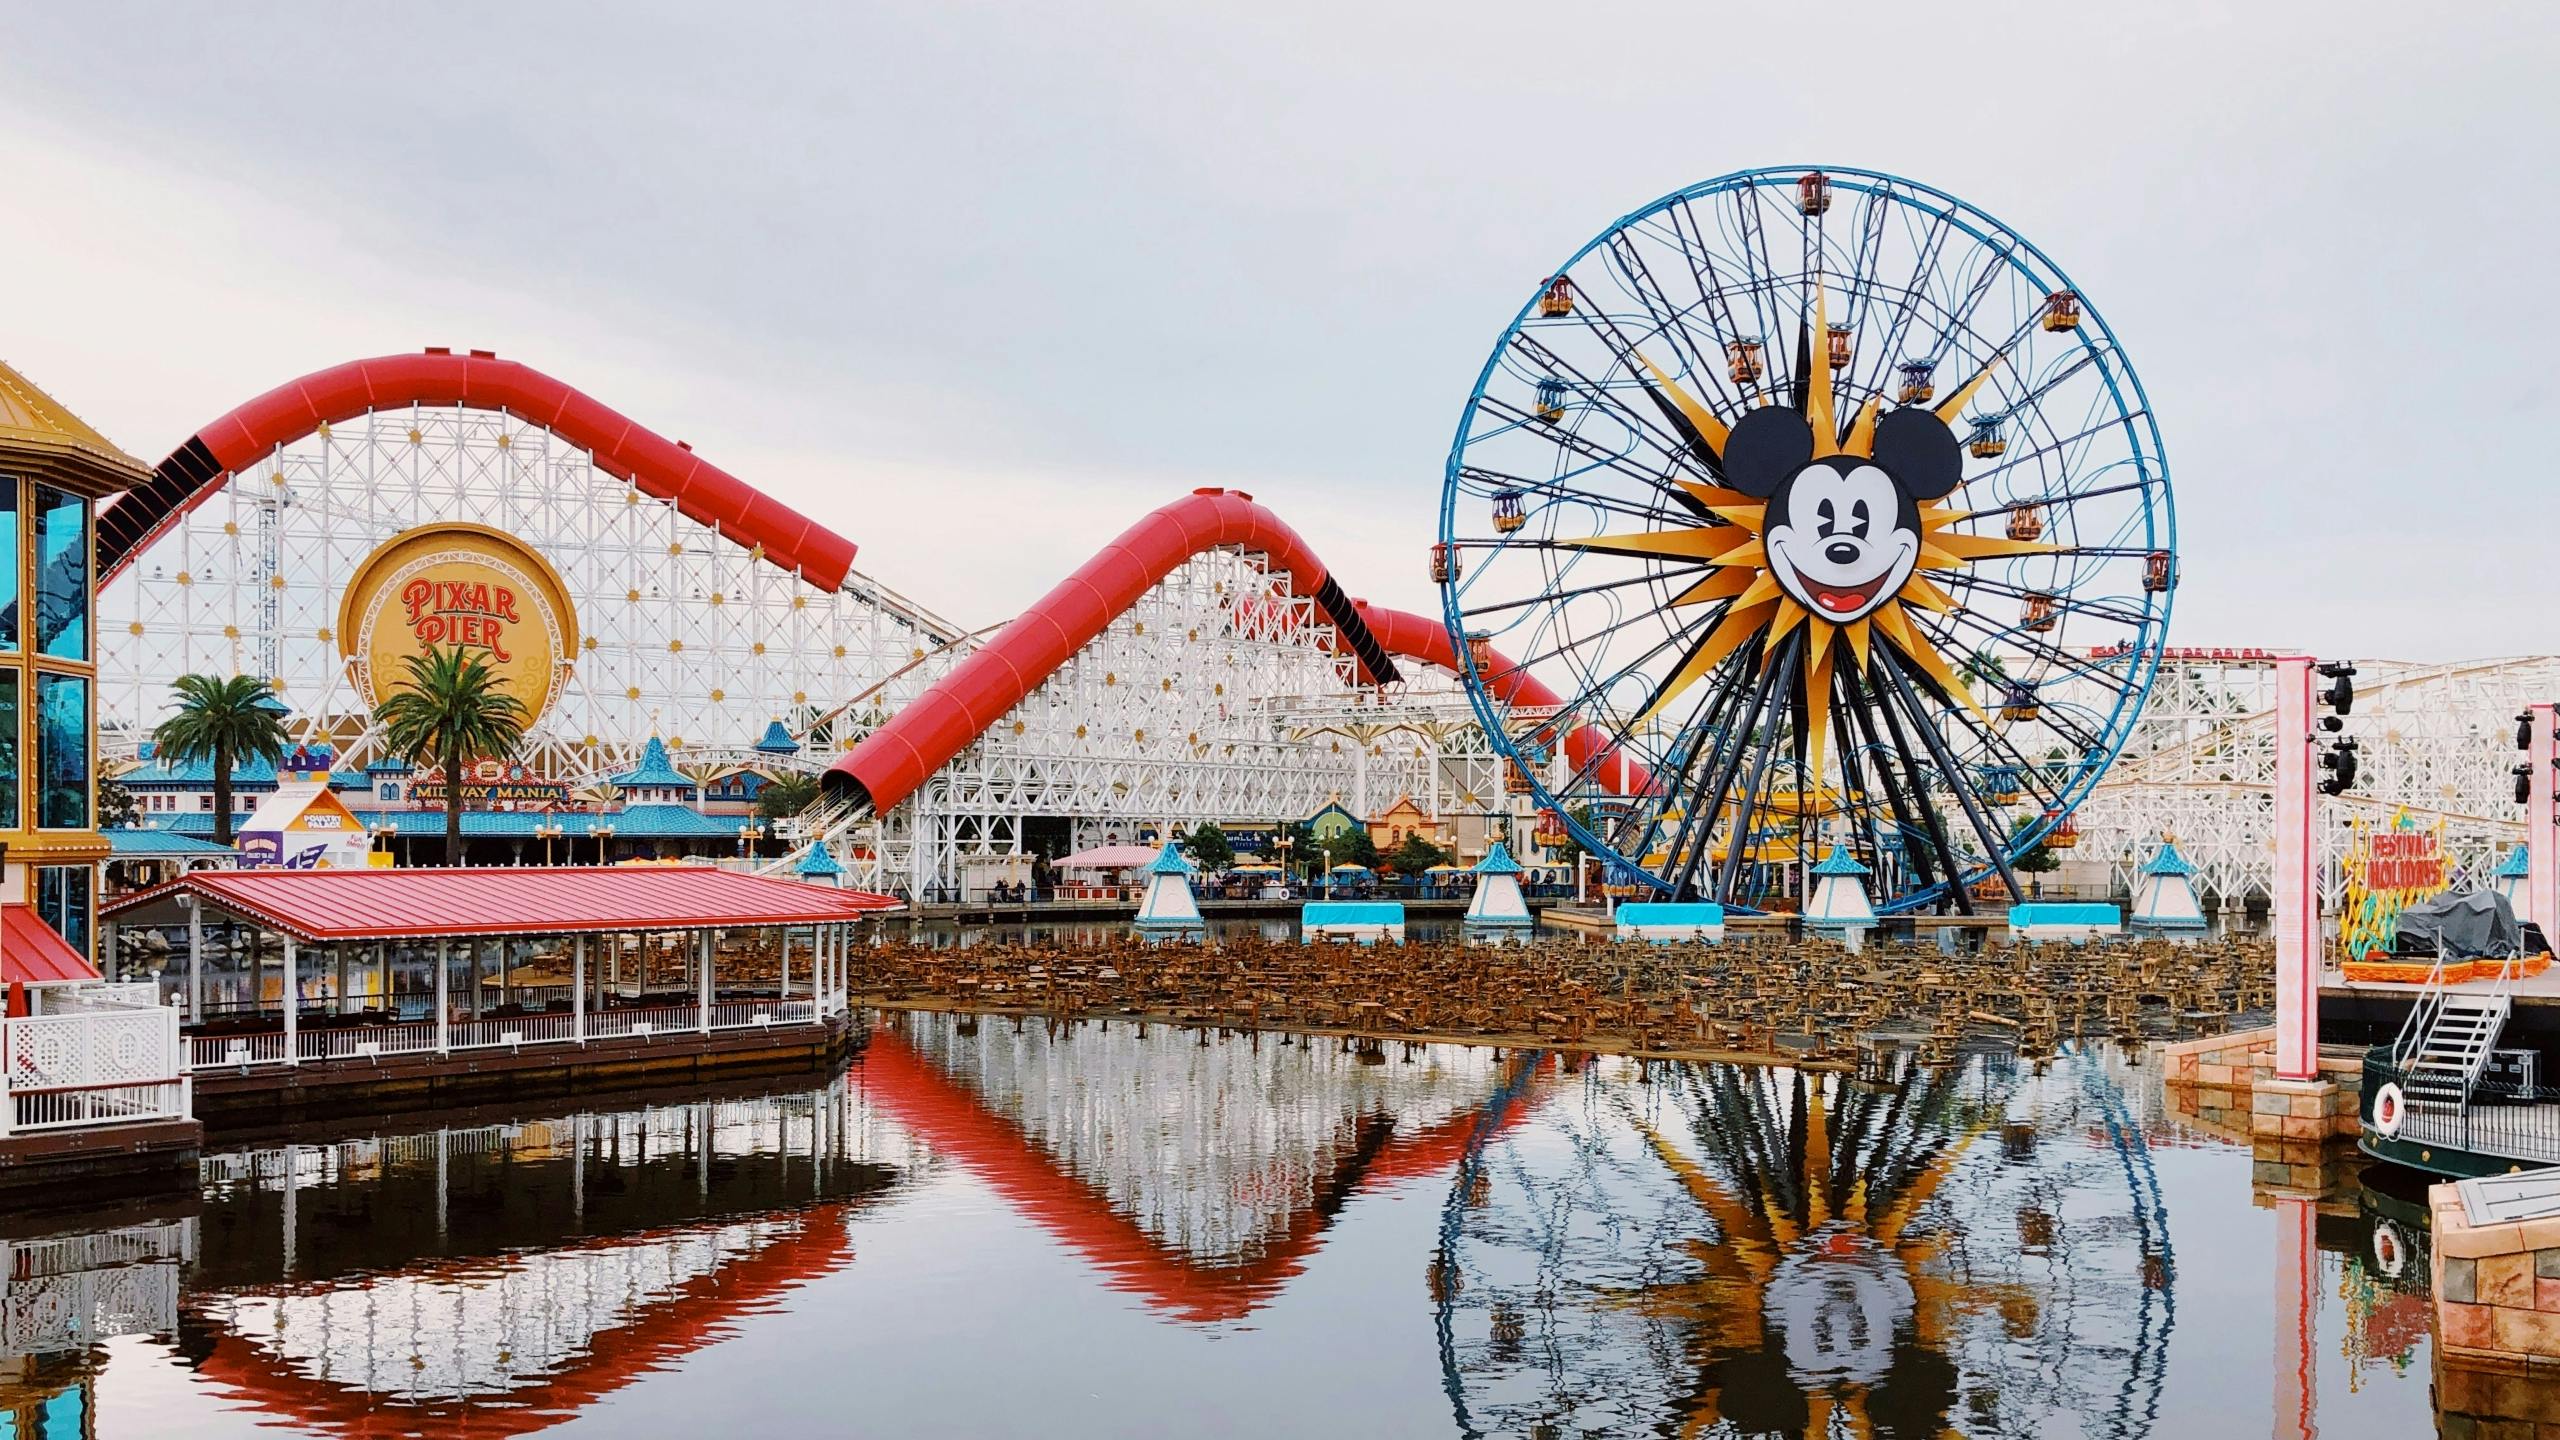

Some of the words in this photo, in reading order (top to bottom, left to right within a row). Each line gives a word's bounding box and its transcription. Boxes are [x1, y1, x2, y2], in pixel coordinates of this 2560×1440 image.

[402, 577, 519, 624] PIXAR
[415, 614, 511, 663] PIER
[497, 787, 562, 798] MANIA!
[303, 814, 341, 823] POULTRY
[2372, 834, 2428, 857] FESTIVAL
[2367, 858, 2443, 890] HOLIDAYS
